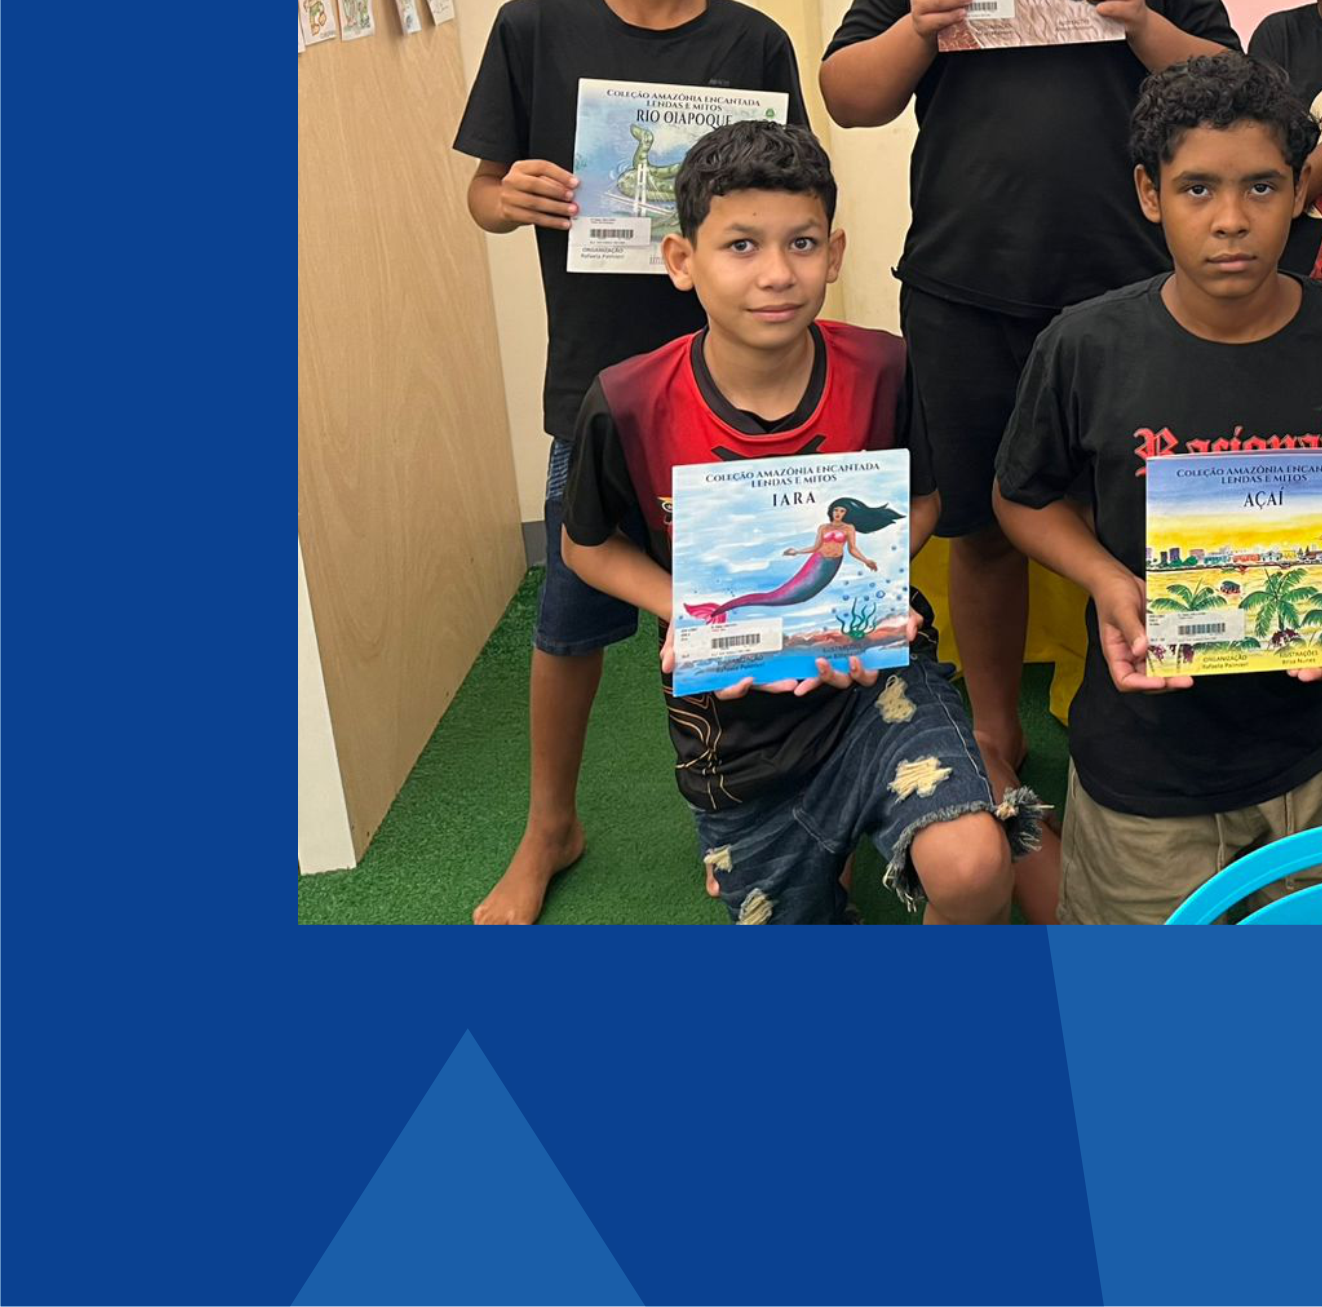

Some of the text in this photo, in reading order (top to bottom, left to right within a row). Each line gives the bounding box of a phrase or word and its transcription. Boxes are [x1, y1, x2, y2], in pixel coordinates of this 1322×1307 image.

[606, 88, 761, 108] COLEÇÃO AMAZÔNIA ENCANTADA
[646, 100, 723, 112] LENDAS E MITOS
[636, 109, 733, 130] RIO OIAPOQUE
[705, 462, 881, 483] COLEÇÃO AMAZÔNIA ENCANTADA
[1176, 468, 1225, 479] COLEÇÃO
[1226, 464, 1285, 476] AMAZÔNIA
[1220, 473, 1308, 485] LENDAS E MITOS
[751, 474, 838, 489] LENDAS E MITOS
[772, 491, 817, 507] IARA
[1243, 486, 1285, 510] AÇAÍ
